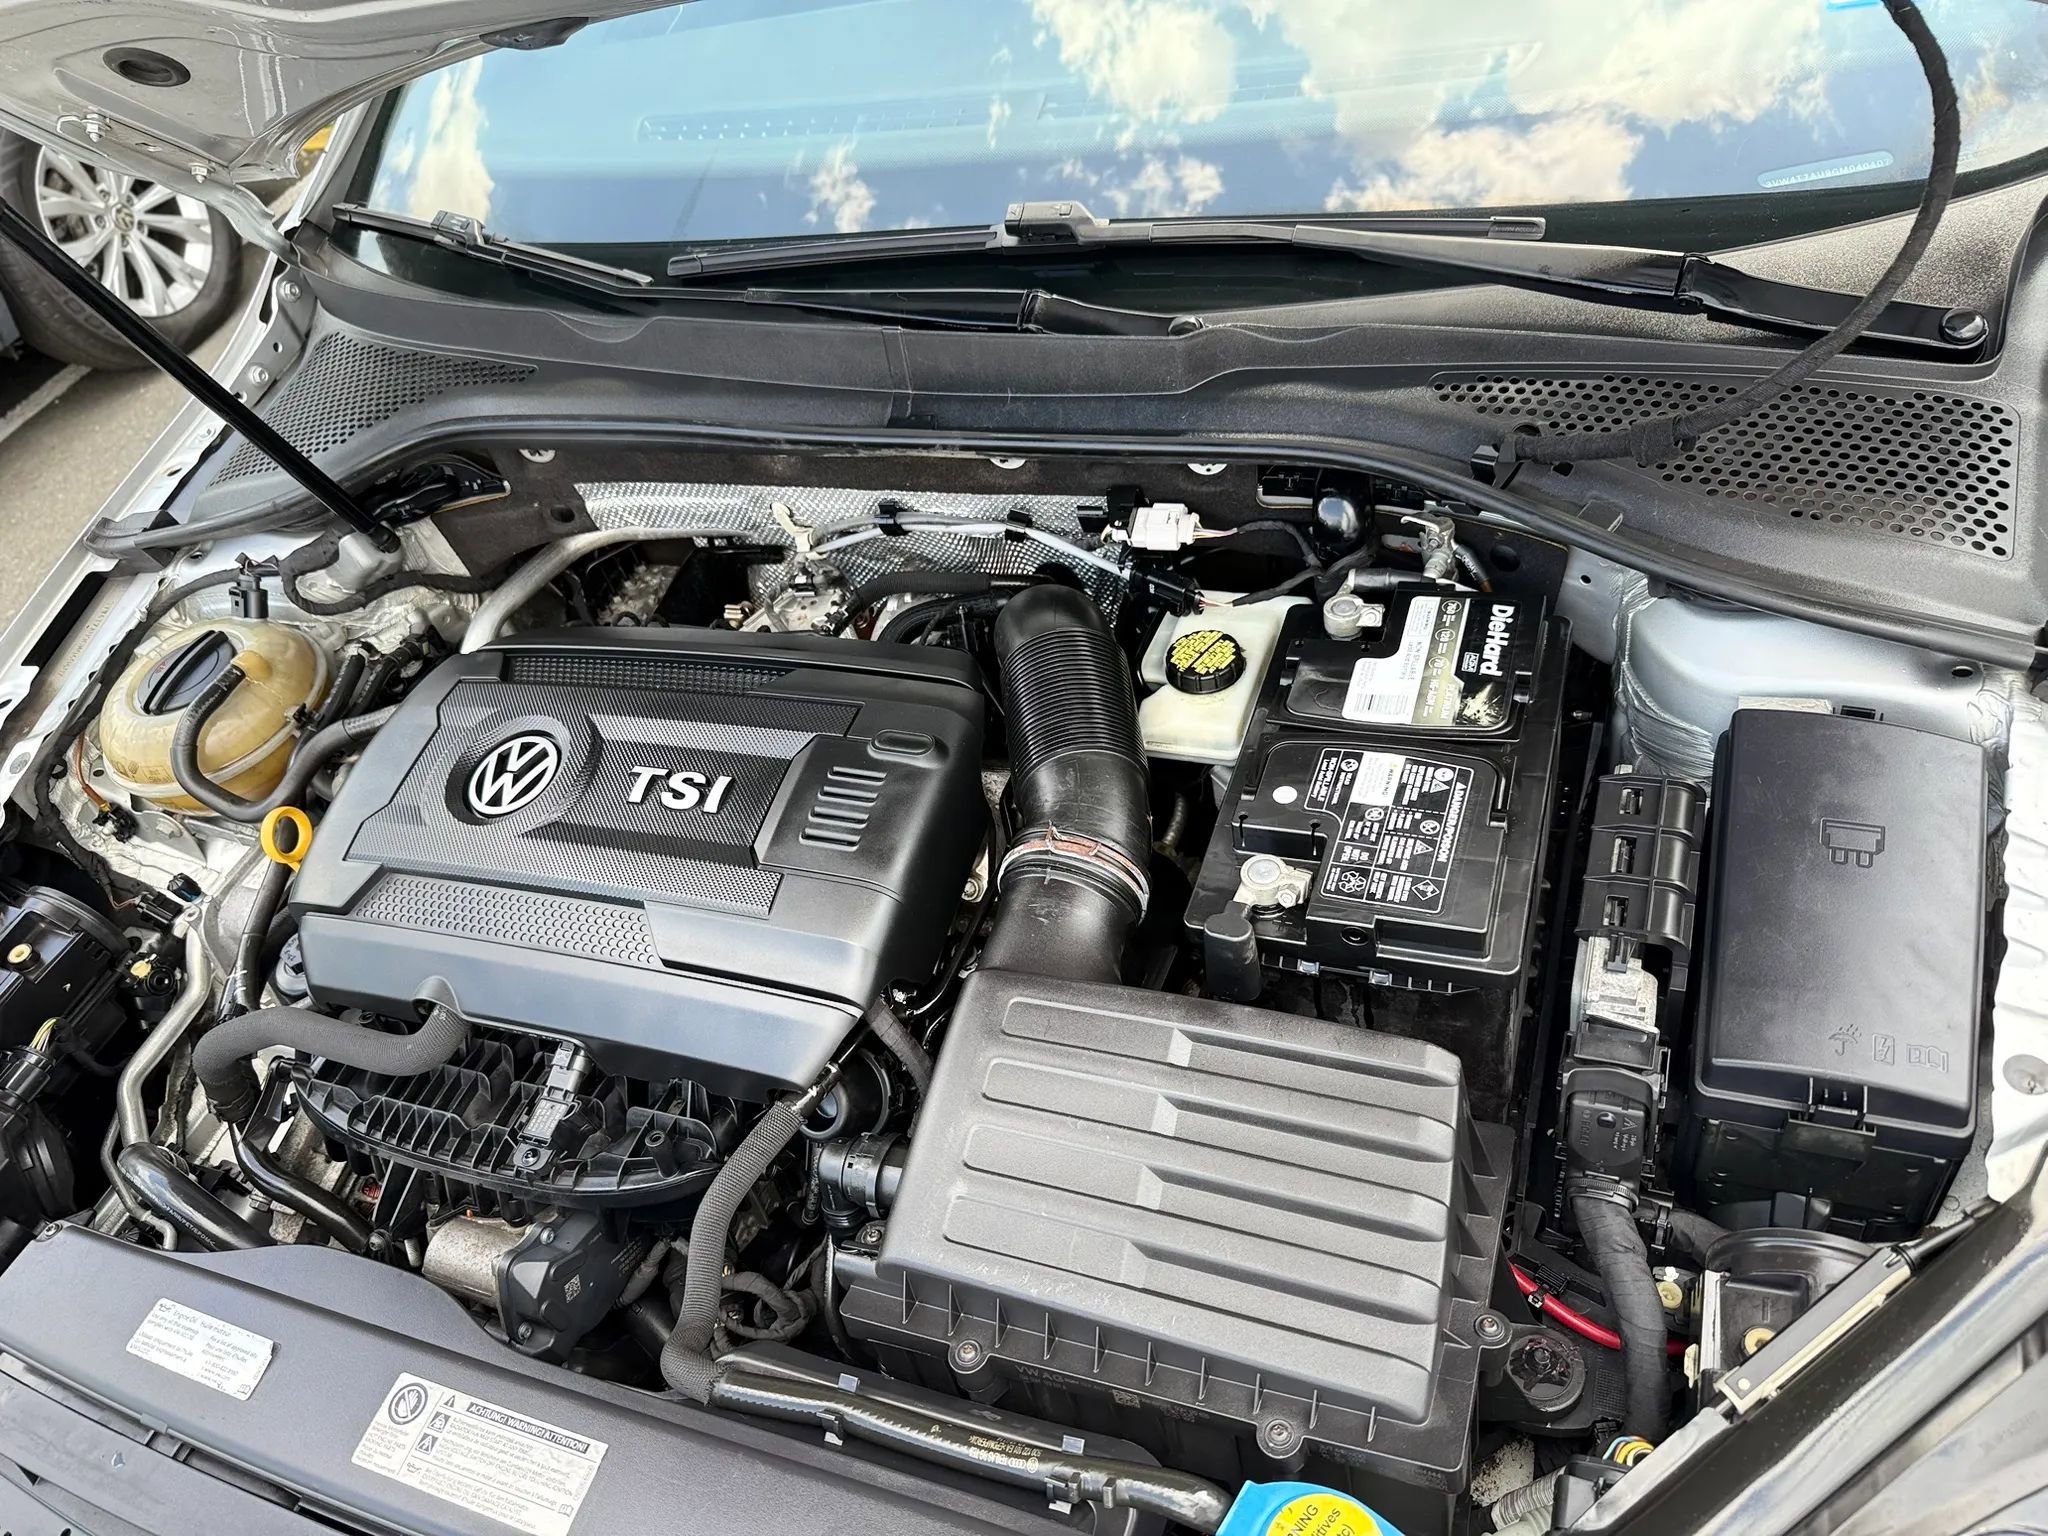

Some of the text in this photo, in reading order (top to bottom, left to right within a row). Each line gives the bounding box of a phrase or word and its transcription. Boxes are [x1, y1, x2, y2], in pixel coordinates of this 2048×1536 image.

[1445, 602, 1457, 614] 760
[1439, 630, 1450, 641] 120
[1479, 604, 1515, 676] DieHard
[1440, 684, 1455, 719] PLATINUM
[627, 765, 733, 815] TSI
[1317, 756, 1337, 803] NON-SPILLABLE
[1437, 790, 1463, 862] DANGER/POISON
[467, 1403, 588, 1453] ACHTUNG! WARNING! ATTENTION!
